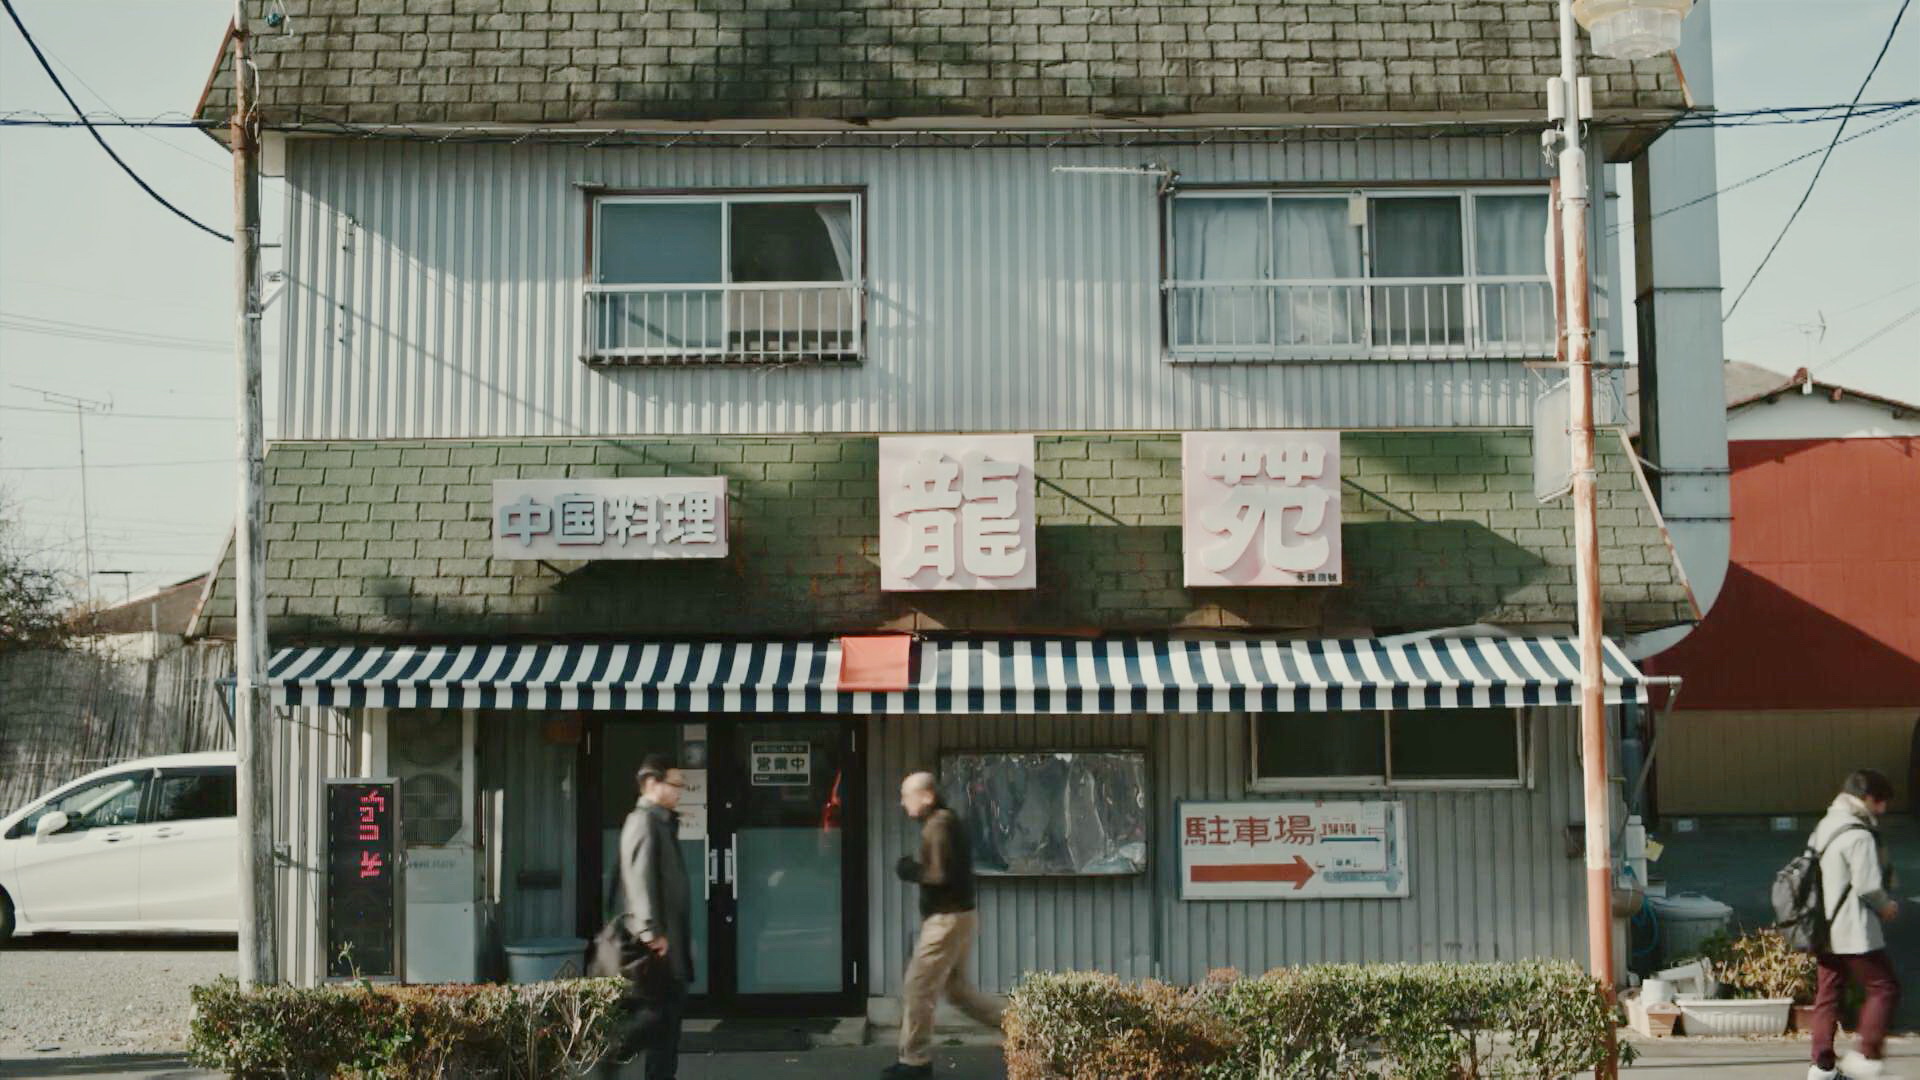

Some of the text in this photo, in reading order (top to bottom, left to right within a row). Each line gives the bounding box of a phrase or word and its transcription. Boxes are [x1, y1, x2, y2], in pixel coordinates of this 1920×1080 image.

[499, 490, 718, 548] 中国料理
[892, 450, 1027, 580] 龍
[1201, 444, 1330, 575] 苑
[1183, 815, 1316, 848] 駐車場
